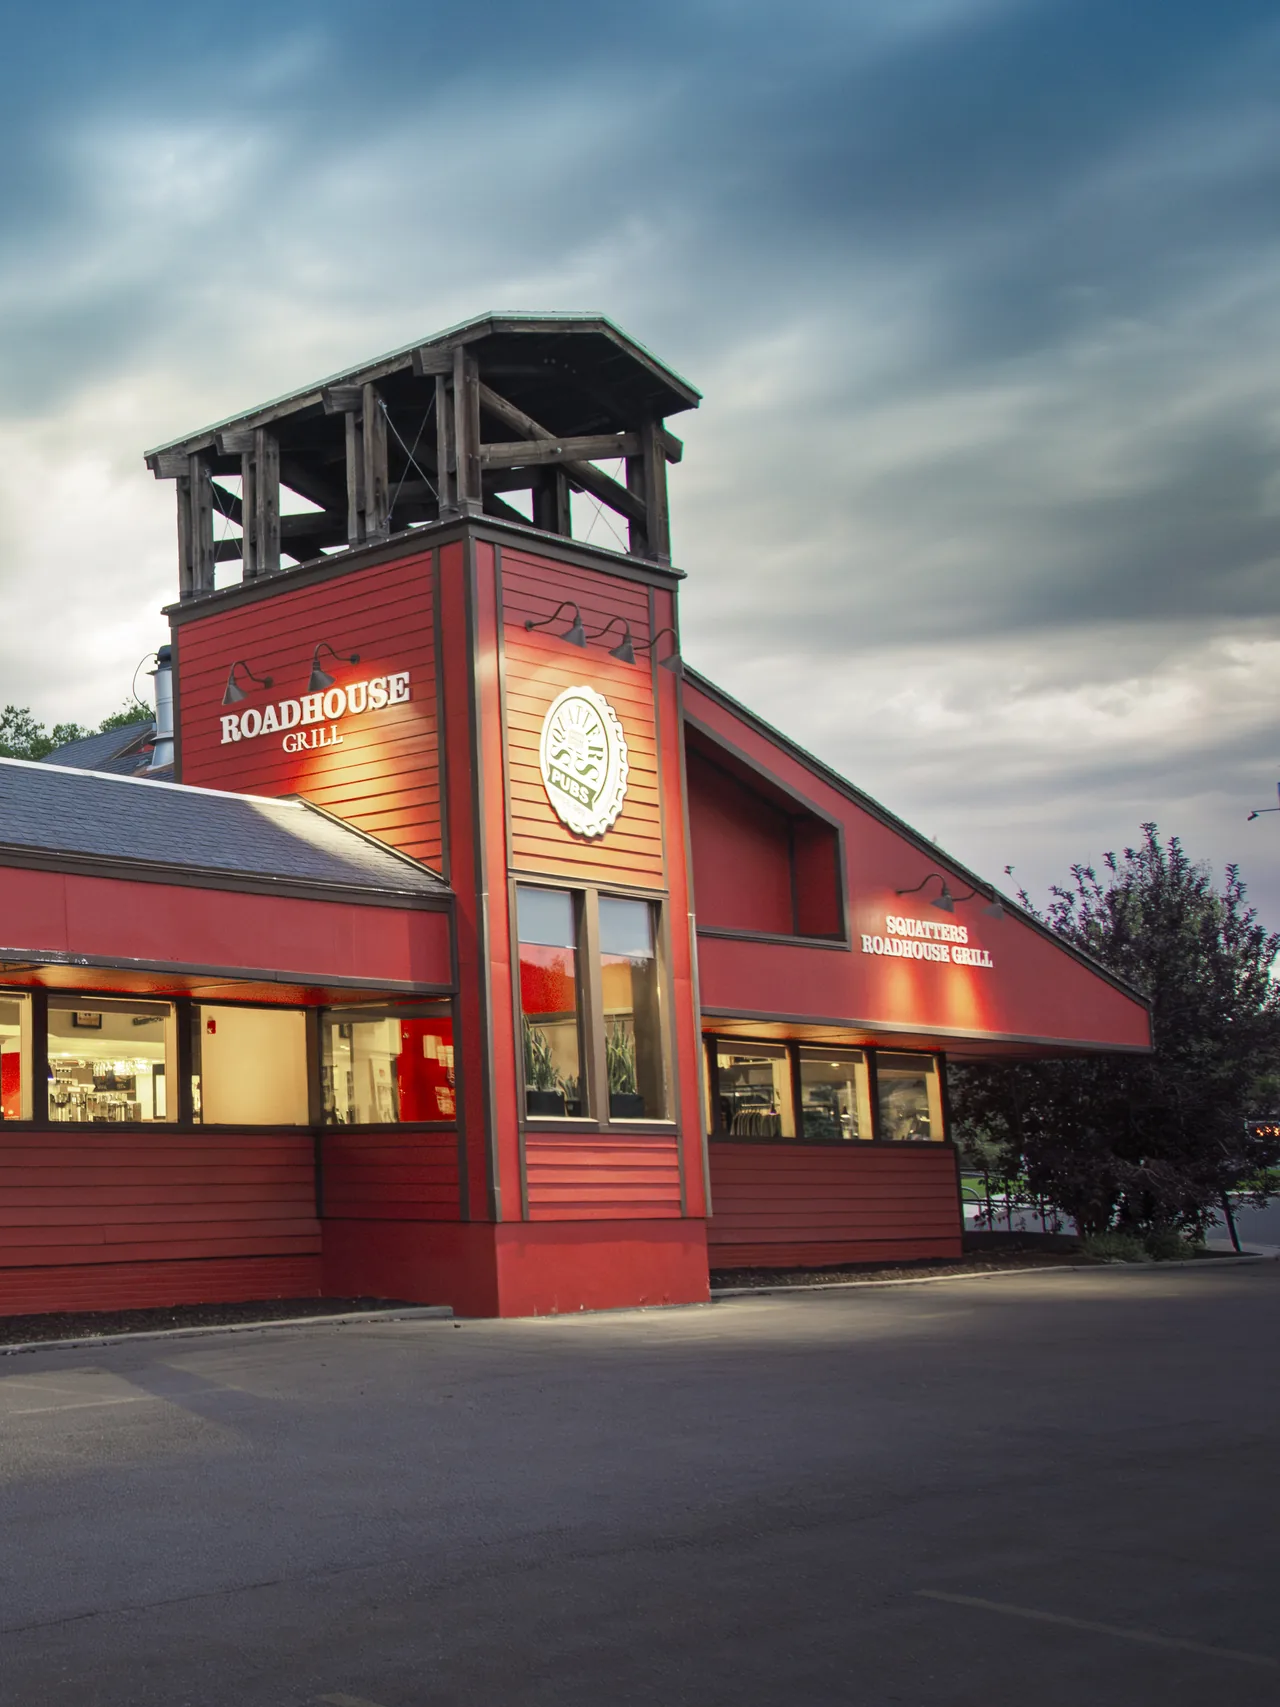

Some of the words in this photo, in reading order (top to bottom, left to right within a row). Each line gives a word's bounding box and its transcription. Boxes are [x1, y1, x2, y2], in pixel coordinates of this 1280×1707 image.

[220, 671, 410, 744] ROADHOUSE
[282, 725, 344, 753] GRILL
[550, 704, 605, 783] SQUATTERS
[551, 768, 590, 804] PUBS
[886, 915, 969, 944] SQUATTERS
[861, 934, 950, 963] ROADHOUSE
[951, 946, 993, 968] GRILL
